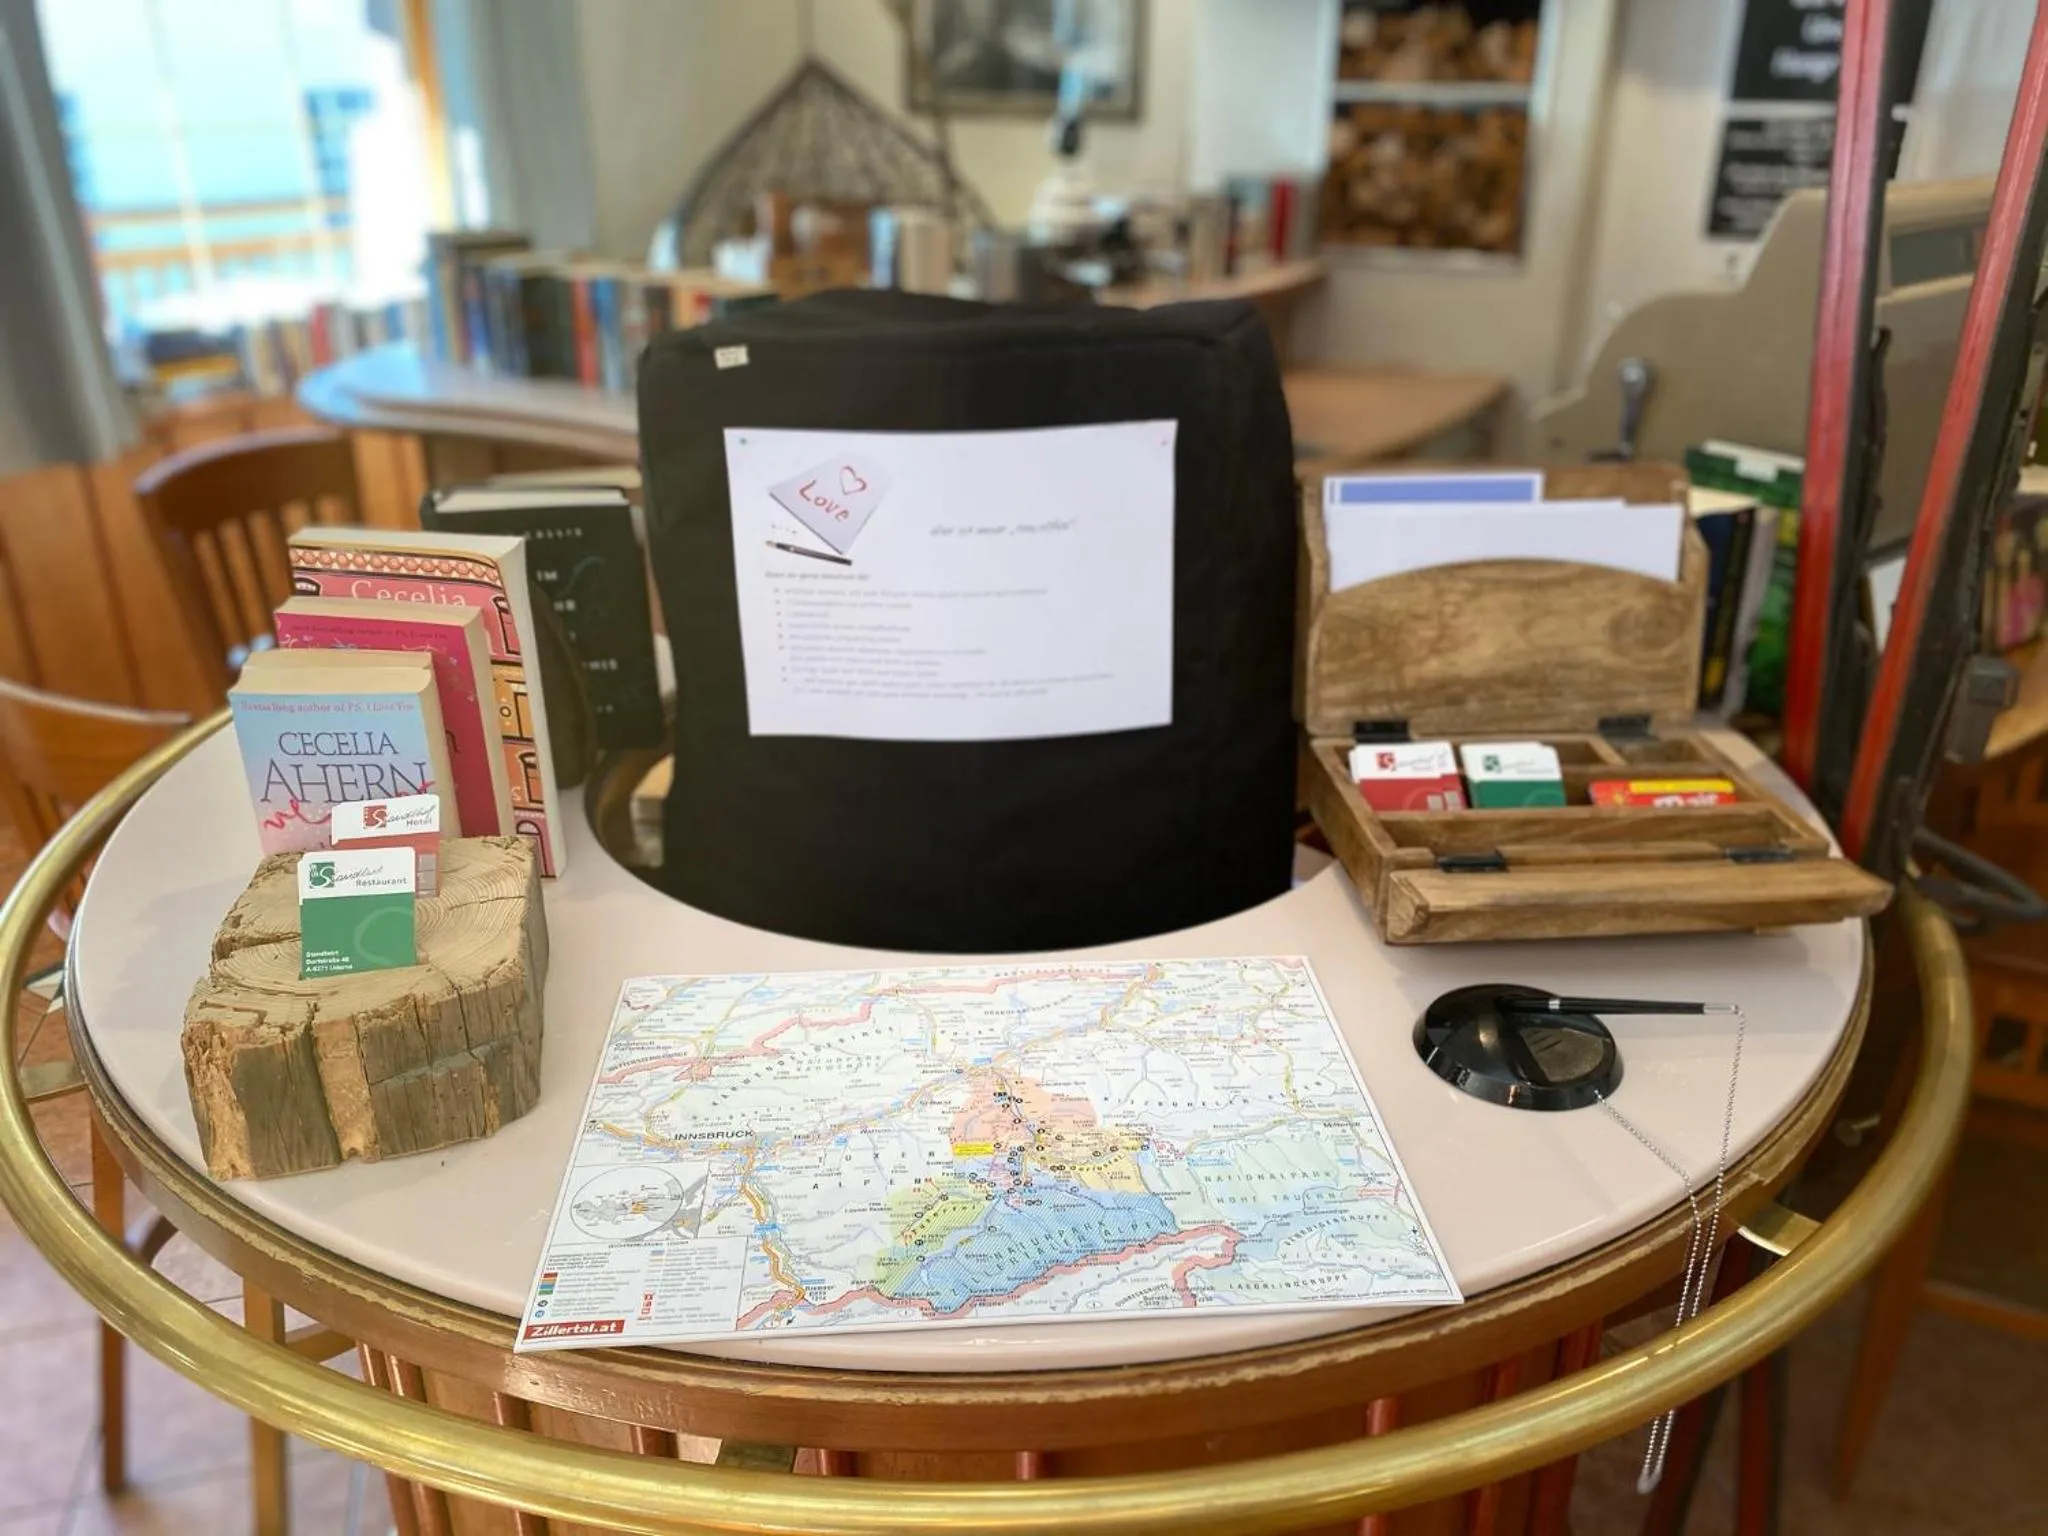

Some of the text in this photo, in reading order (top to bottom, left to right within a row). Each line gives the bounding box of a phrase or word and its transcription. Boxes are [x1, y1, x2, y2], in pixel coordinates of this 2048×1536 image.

[799, 479, 850, 521] Love
[351, 581, 467, 606] Cecelia
[240, 701, 295, 713] Bestselling
[297, 703, 331, 712] author
[334, 702, 346, 712] of
[278, 731, 400, 756] CECELIA
[260, 757, 427, 804] AHERN
[406, 818, 433, 826] Hotel
[355, 877, 407, 888] Restaurant
[673, 1129, 754, 1142] INNSBRUCK
[1205, 1170, 1331, 1183] NATIONALPARK
[531, 1321, 617, 1337] Zillertal.at
